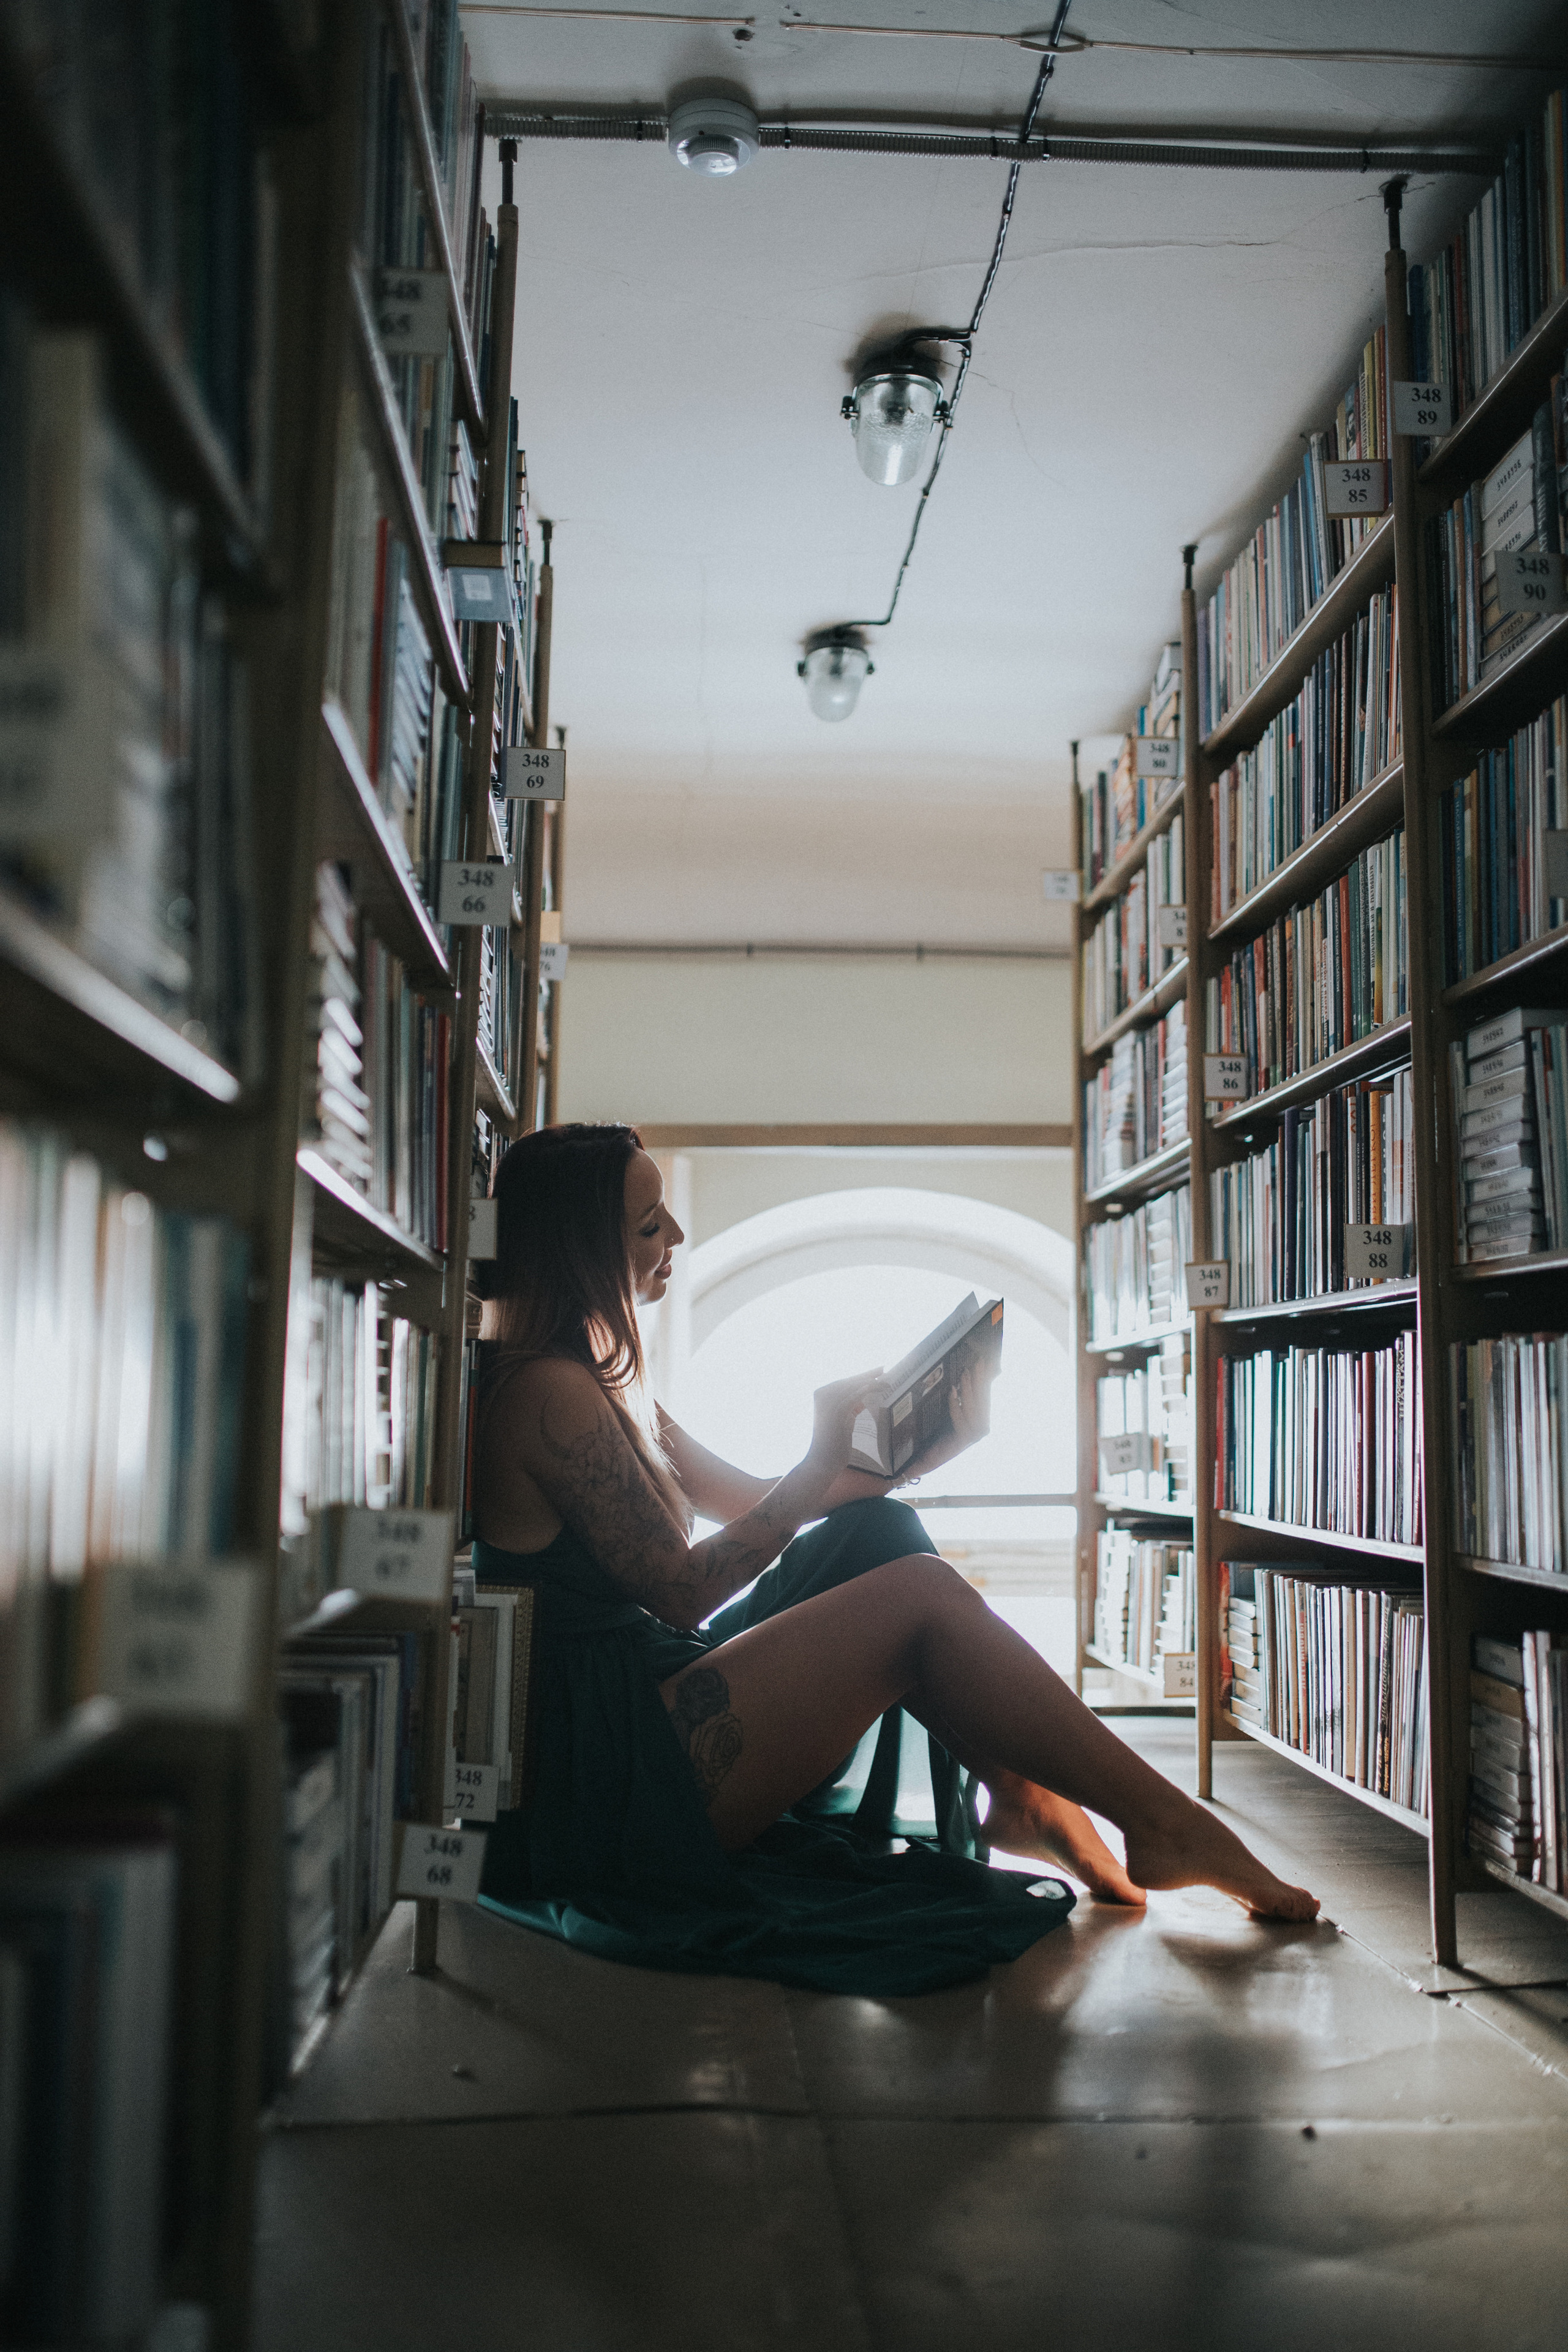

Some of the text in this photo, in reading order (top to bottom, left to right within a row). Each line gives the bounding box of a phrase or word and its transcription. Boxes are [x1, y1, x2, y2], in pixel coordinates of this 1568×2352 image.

[1412, 387, 1442, 402] 348
[1418, 410, 1438, 425] 89
[1342, 467, 1372, 483] 348
[1348, 488, 1368, 503] 85
[1517, 557, 1550, 576] 348
[1524, 584, 1547, 600] 90
[1149, 742, 1170, 753] 348
[522, 753, 549, 768] 348
[526, 775, 545, 789] 69
[458, 869, 494, 887] 348
[462, 896, 486, 913] 66
[1174, 911, 1186, 921] 34
[1219, 1061, 1242, 1072] 348
[1223, 1078, 1238, 1090] 86
[1363, 1230, 1393, 1246] 348
[1368, 1253, 1389, 1268] 88
[1199, 1268, 1222, 1281] 348
[1204, 1286, 1219, 1298] 87
[1180, 1678, 1193, 1687] 84
[454, 1769, 482, 1786] 348
[456, 1793, 475, 1809] 72
[424, 1835, 463, 1856] 348
[427, 1866, 453, 1885] 68
